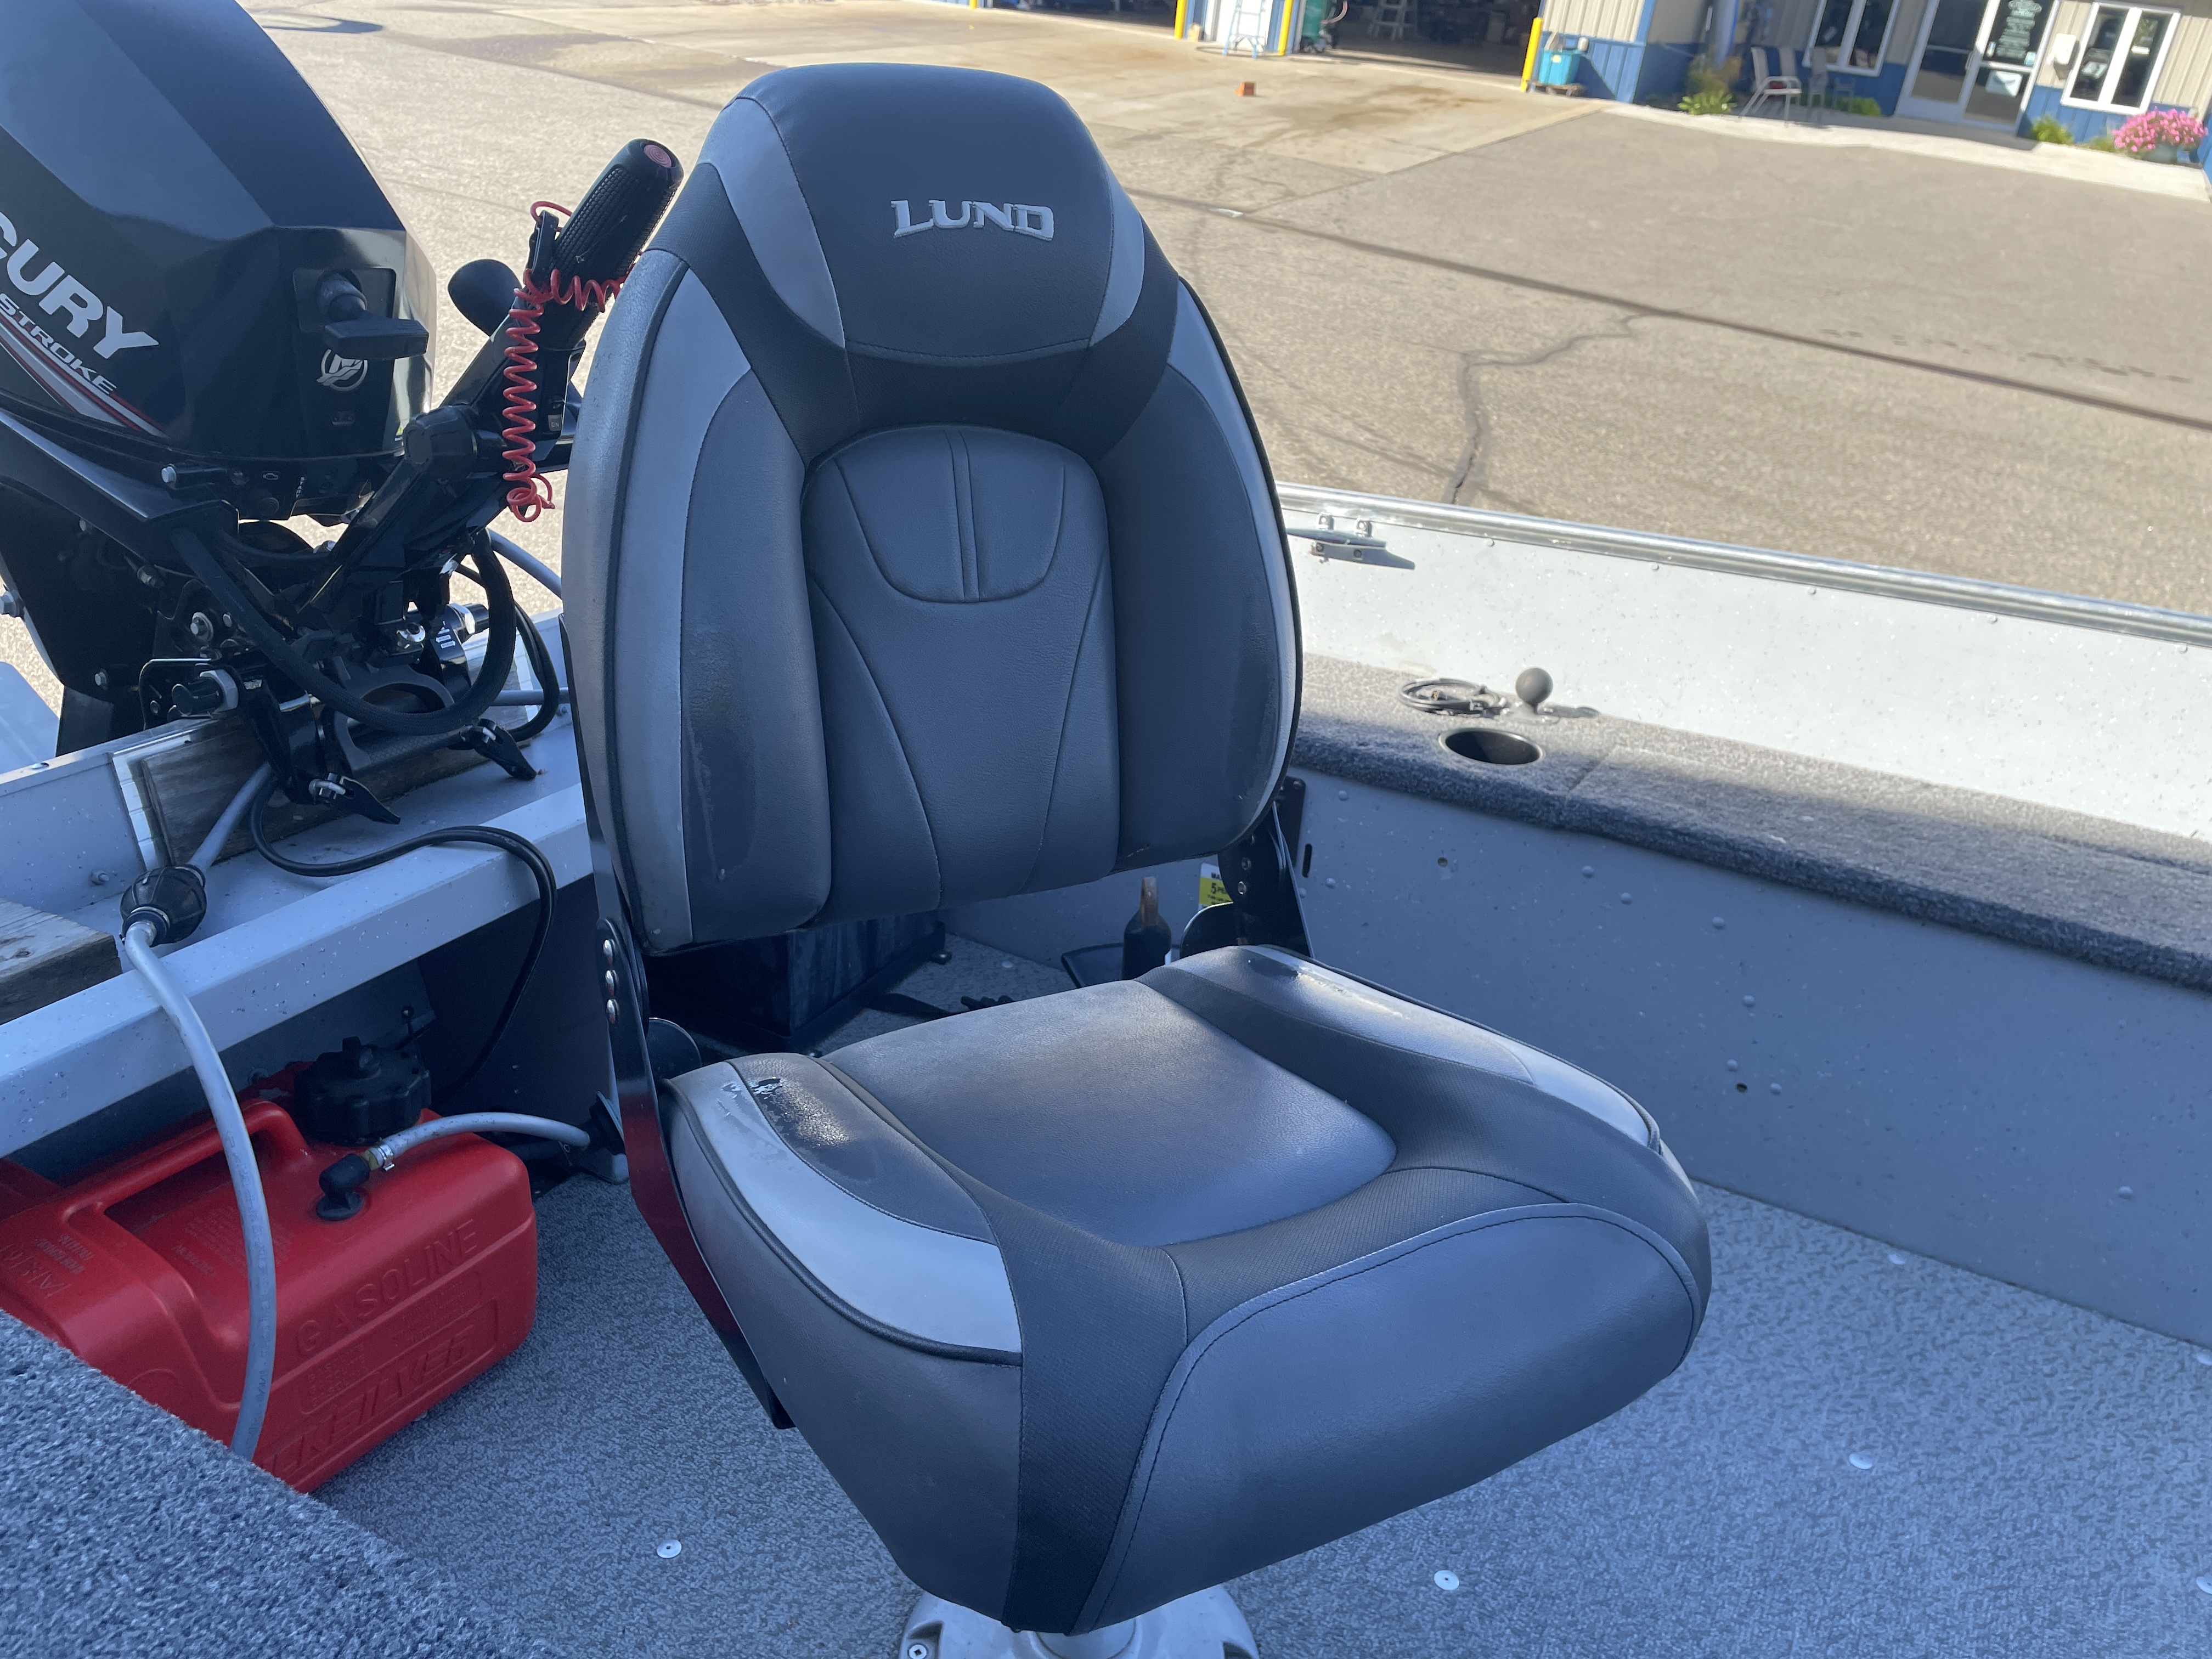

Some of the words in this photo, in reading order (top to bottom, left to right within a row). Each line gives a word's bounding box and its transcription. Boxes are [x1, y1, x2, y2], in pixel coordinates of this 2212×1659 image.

[890, 199, 1054, 241] LUND
[0, 293, 117, 394] STROKE
[296, 1218, 478, 1352] GASOLINE
